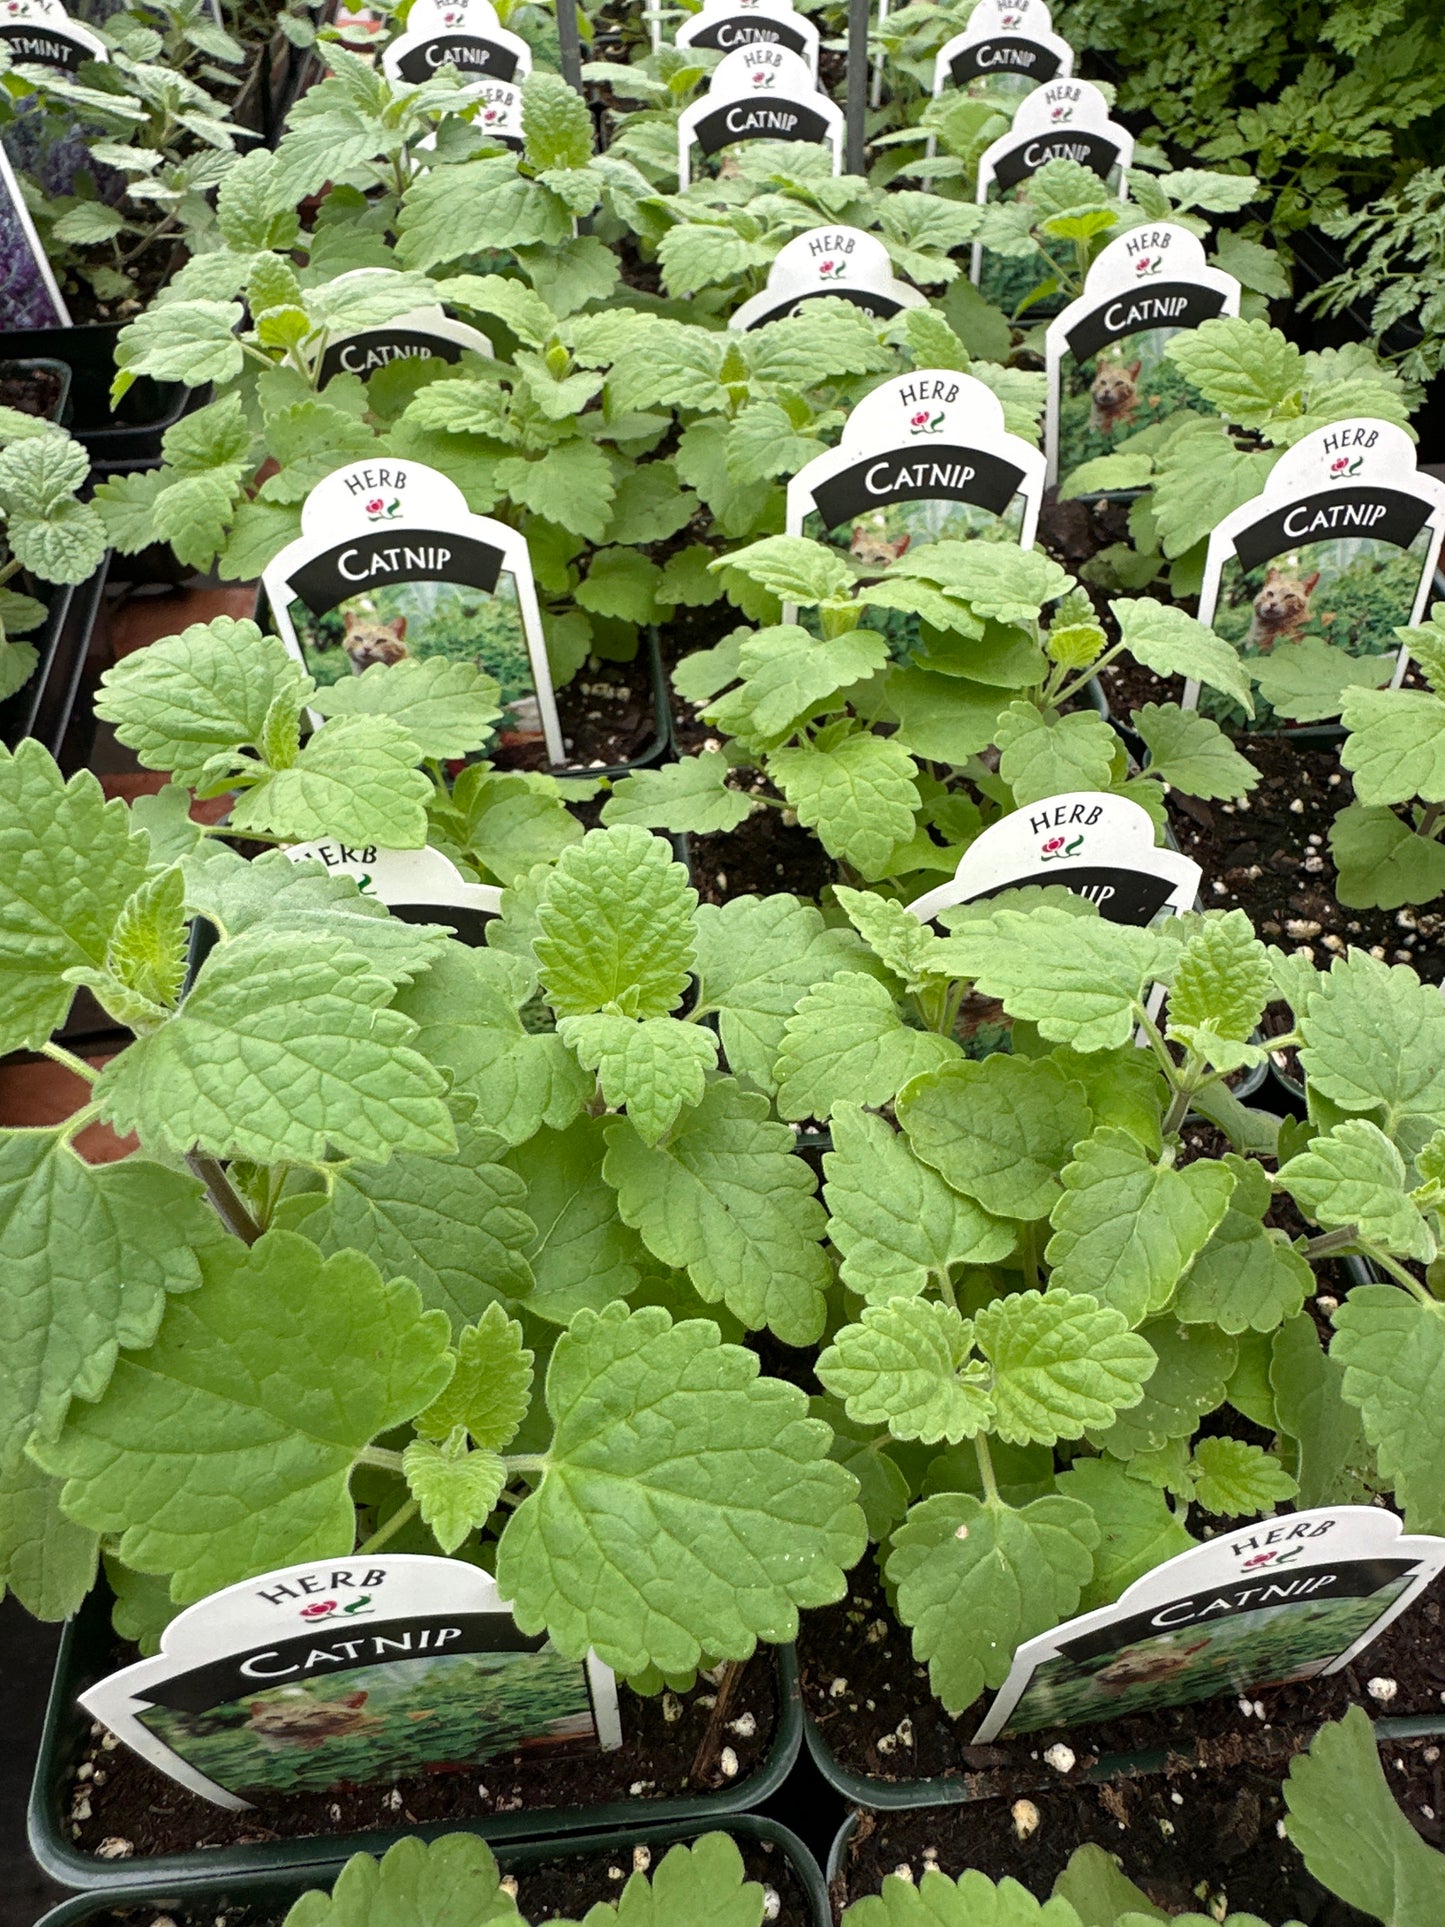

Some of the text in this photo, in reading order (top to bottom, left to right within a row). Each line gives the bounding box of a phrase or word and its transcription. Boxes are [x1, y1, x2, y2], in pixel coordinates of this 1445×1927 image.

[717, 24, 780, 47] CATNIP
[424, 44, 490, 67] CATNIP
[743, 50, 783, 68] HERB
[976, 45, 1036, 68] CATNIP
[1045, 86, 1081, 104] HERB
[725, 107, 798, 132] CATNIP
[1023, 142, 1091, 167] CATNIP
[808, 234, 856, 257] HERB
[1126, 231, 1171, 256] HERB
[1103, 297, 1188, 331] CATNIP
[339, 344, 432, 373] CATNIP
[899, 380, 959, 407] HERB
[1322, 427, 1379, 454] HERB
[344, 468, 407, 496] HERB
[864, 461, 976, 495] CATNIP
[1282, 504, 1387, 538] CATNIP
[337, 547, 452, 581] CATNIP
[1029, 804, 1104, 835] HERB
[294, 843, 378, 867] ERB
[1230, 1520, 1337, 1556] HERB
[256, 1569, 388, 1606] HERB
[1151, 1574, 1338, 1627] CATNIP
[239, 1628, 463, 1678] CATNIP
